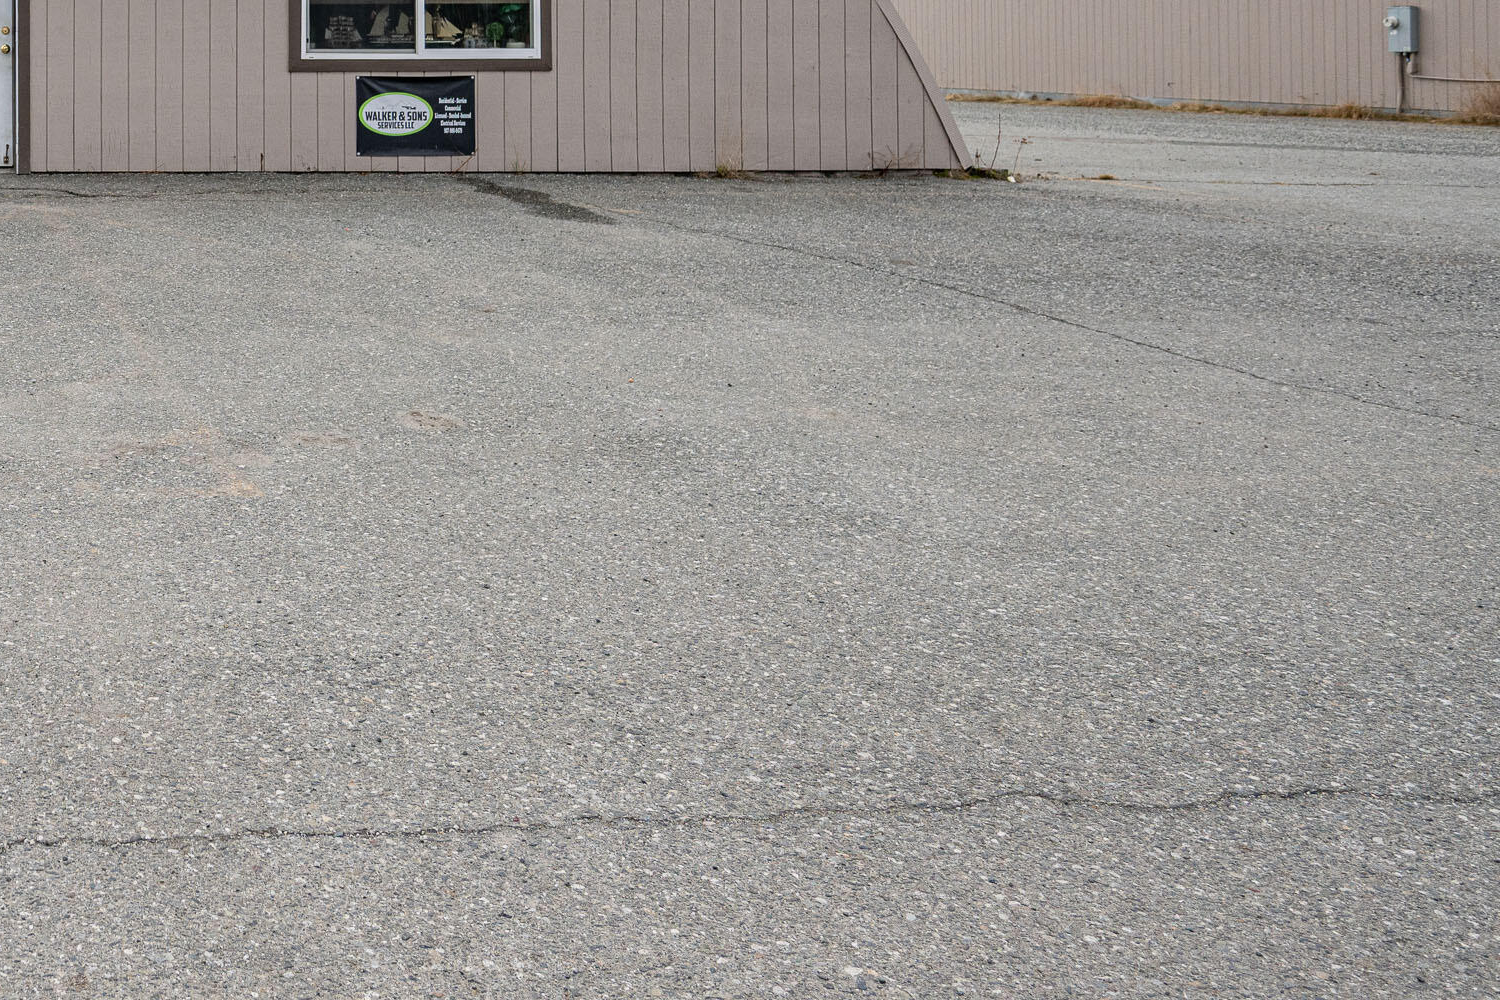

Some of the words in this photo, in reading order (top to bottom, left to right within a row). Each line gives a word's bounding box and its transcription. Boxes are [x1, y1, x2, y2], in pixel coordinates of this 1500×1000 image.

[365, 111, 397, 121] WALKER
[398, 111, 406, 121] &
[407, 111, 428, 121] SONS
[377, 121, 405, 129] SERVICES
[405, 121, 415, 129] LLC
